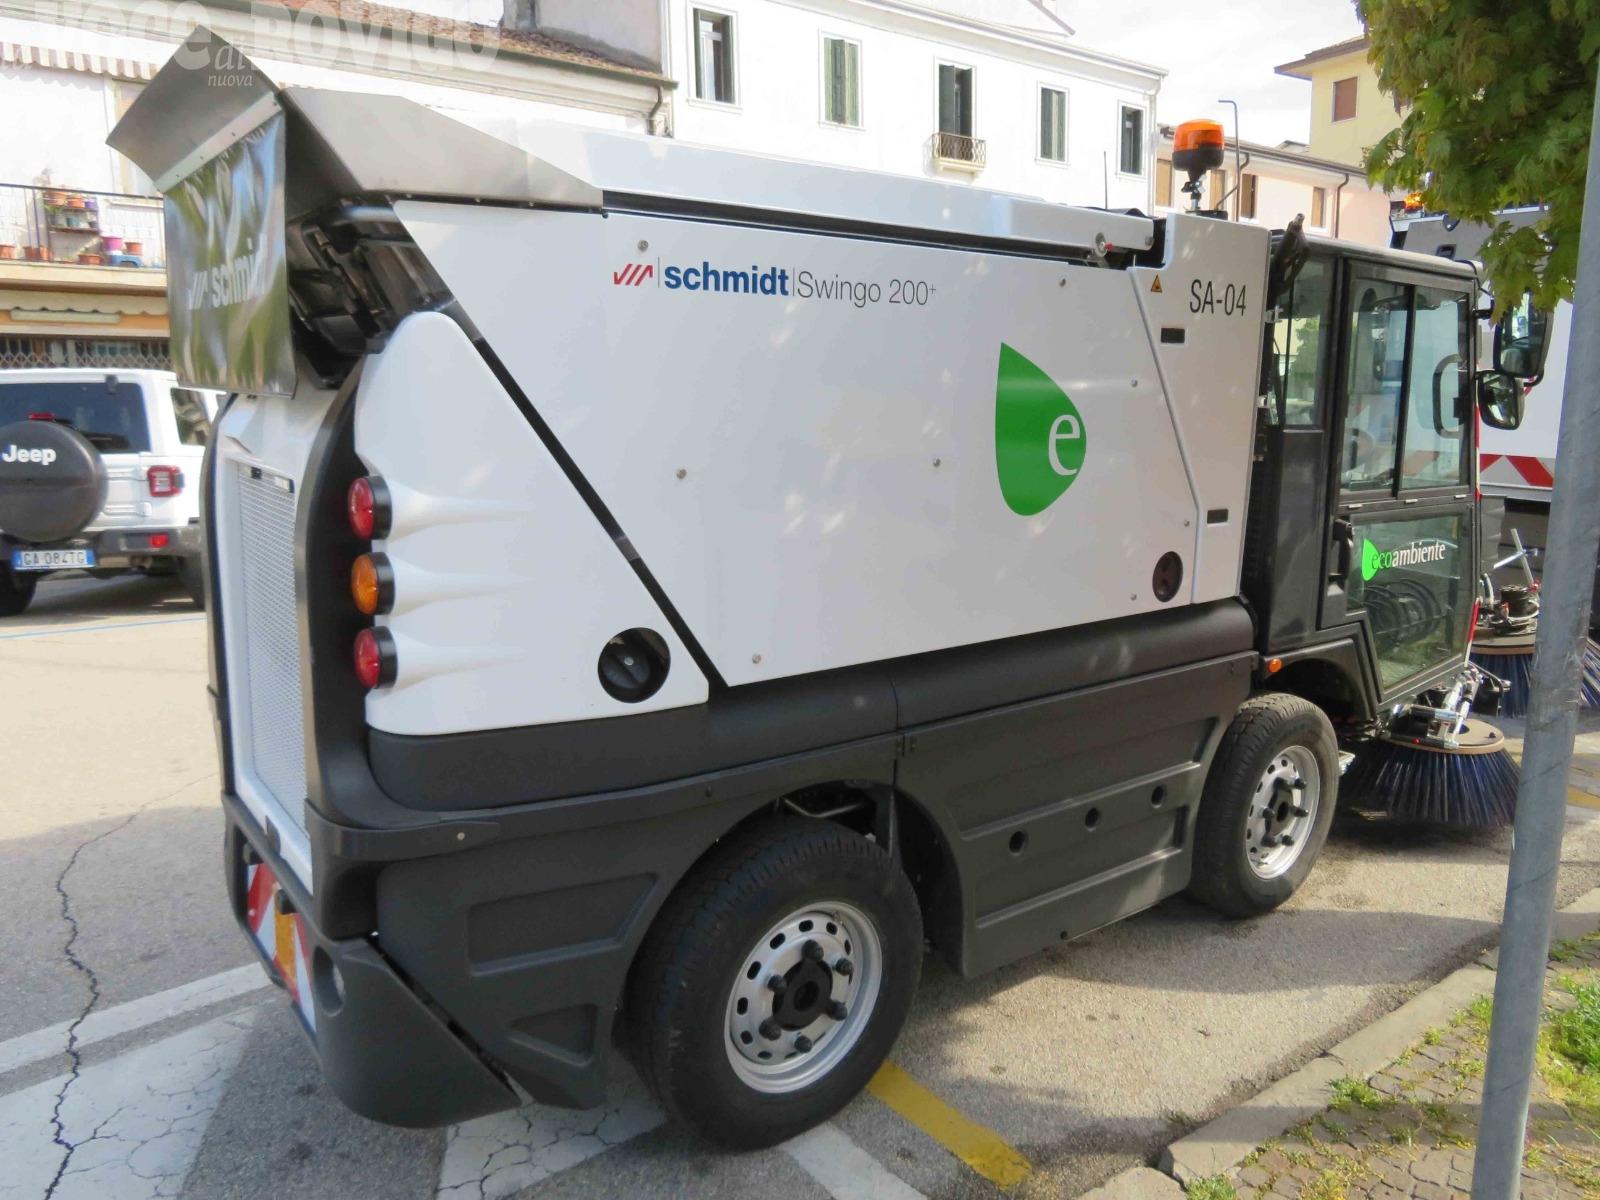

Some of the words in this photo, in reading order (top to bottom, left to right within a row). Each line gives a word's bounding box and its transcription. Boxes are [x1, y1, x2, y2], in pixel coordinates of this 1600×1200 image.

[664, 261, 789, 296] schmidt
[797, 270, 881, 308] Swingo
[1190, 279, 1246, 316] SA-04
[2, 444, 57, 466] Jeep
[1371, 541, 1446, 570] ecoambiente
